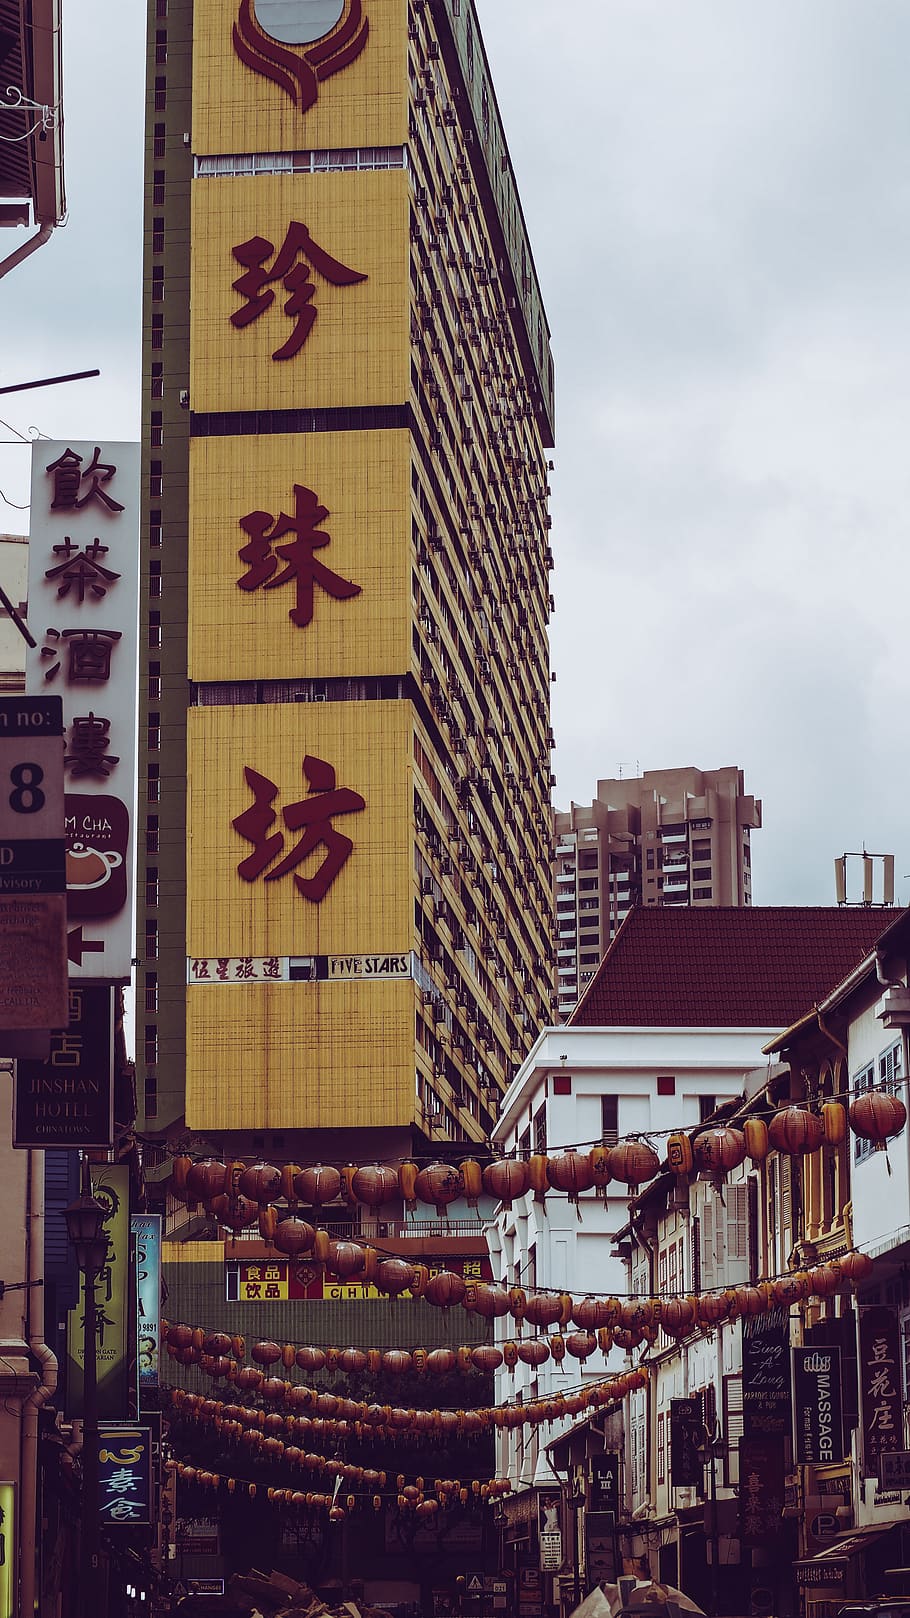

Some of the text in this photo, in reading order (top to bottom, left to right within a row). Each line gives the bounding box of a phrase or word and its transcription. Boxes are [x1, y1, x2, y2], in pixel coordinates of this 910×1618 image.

[229, 220, 369, 904] 珍珠坊
[17, 711, 51, 727] no:
[9, 762, 46, 814] 8
[82, 815, 112, 831] CHA
[331, 956, 408, 975] FIVE STARS
[28, 1078, 100, 1095] JINSHAN
[35, 1101, 94, 1119] HOTEL
[245, 1264, 281, 1281] 食品
[245, 1283, 281, 1299] 饮品
[748, 1339, 785, 1360] Sing
[816, 1374, 834, 1462] MASSAGE
